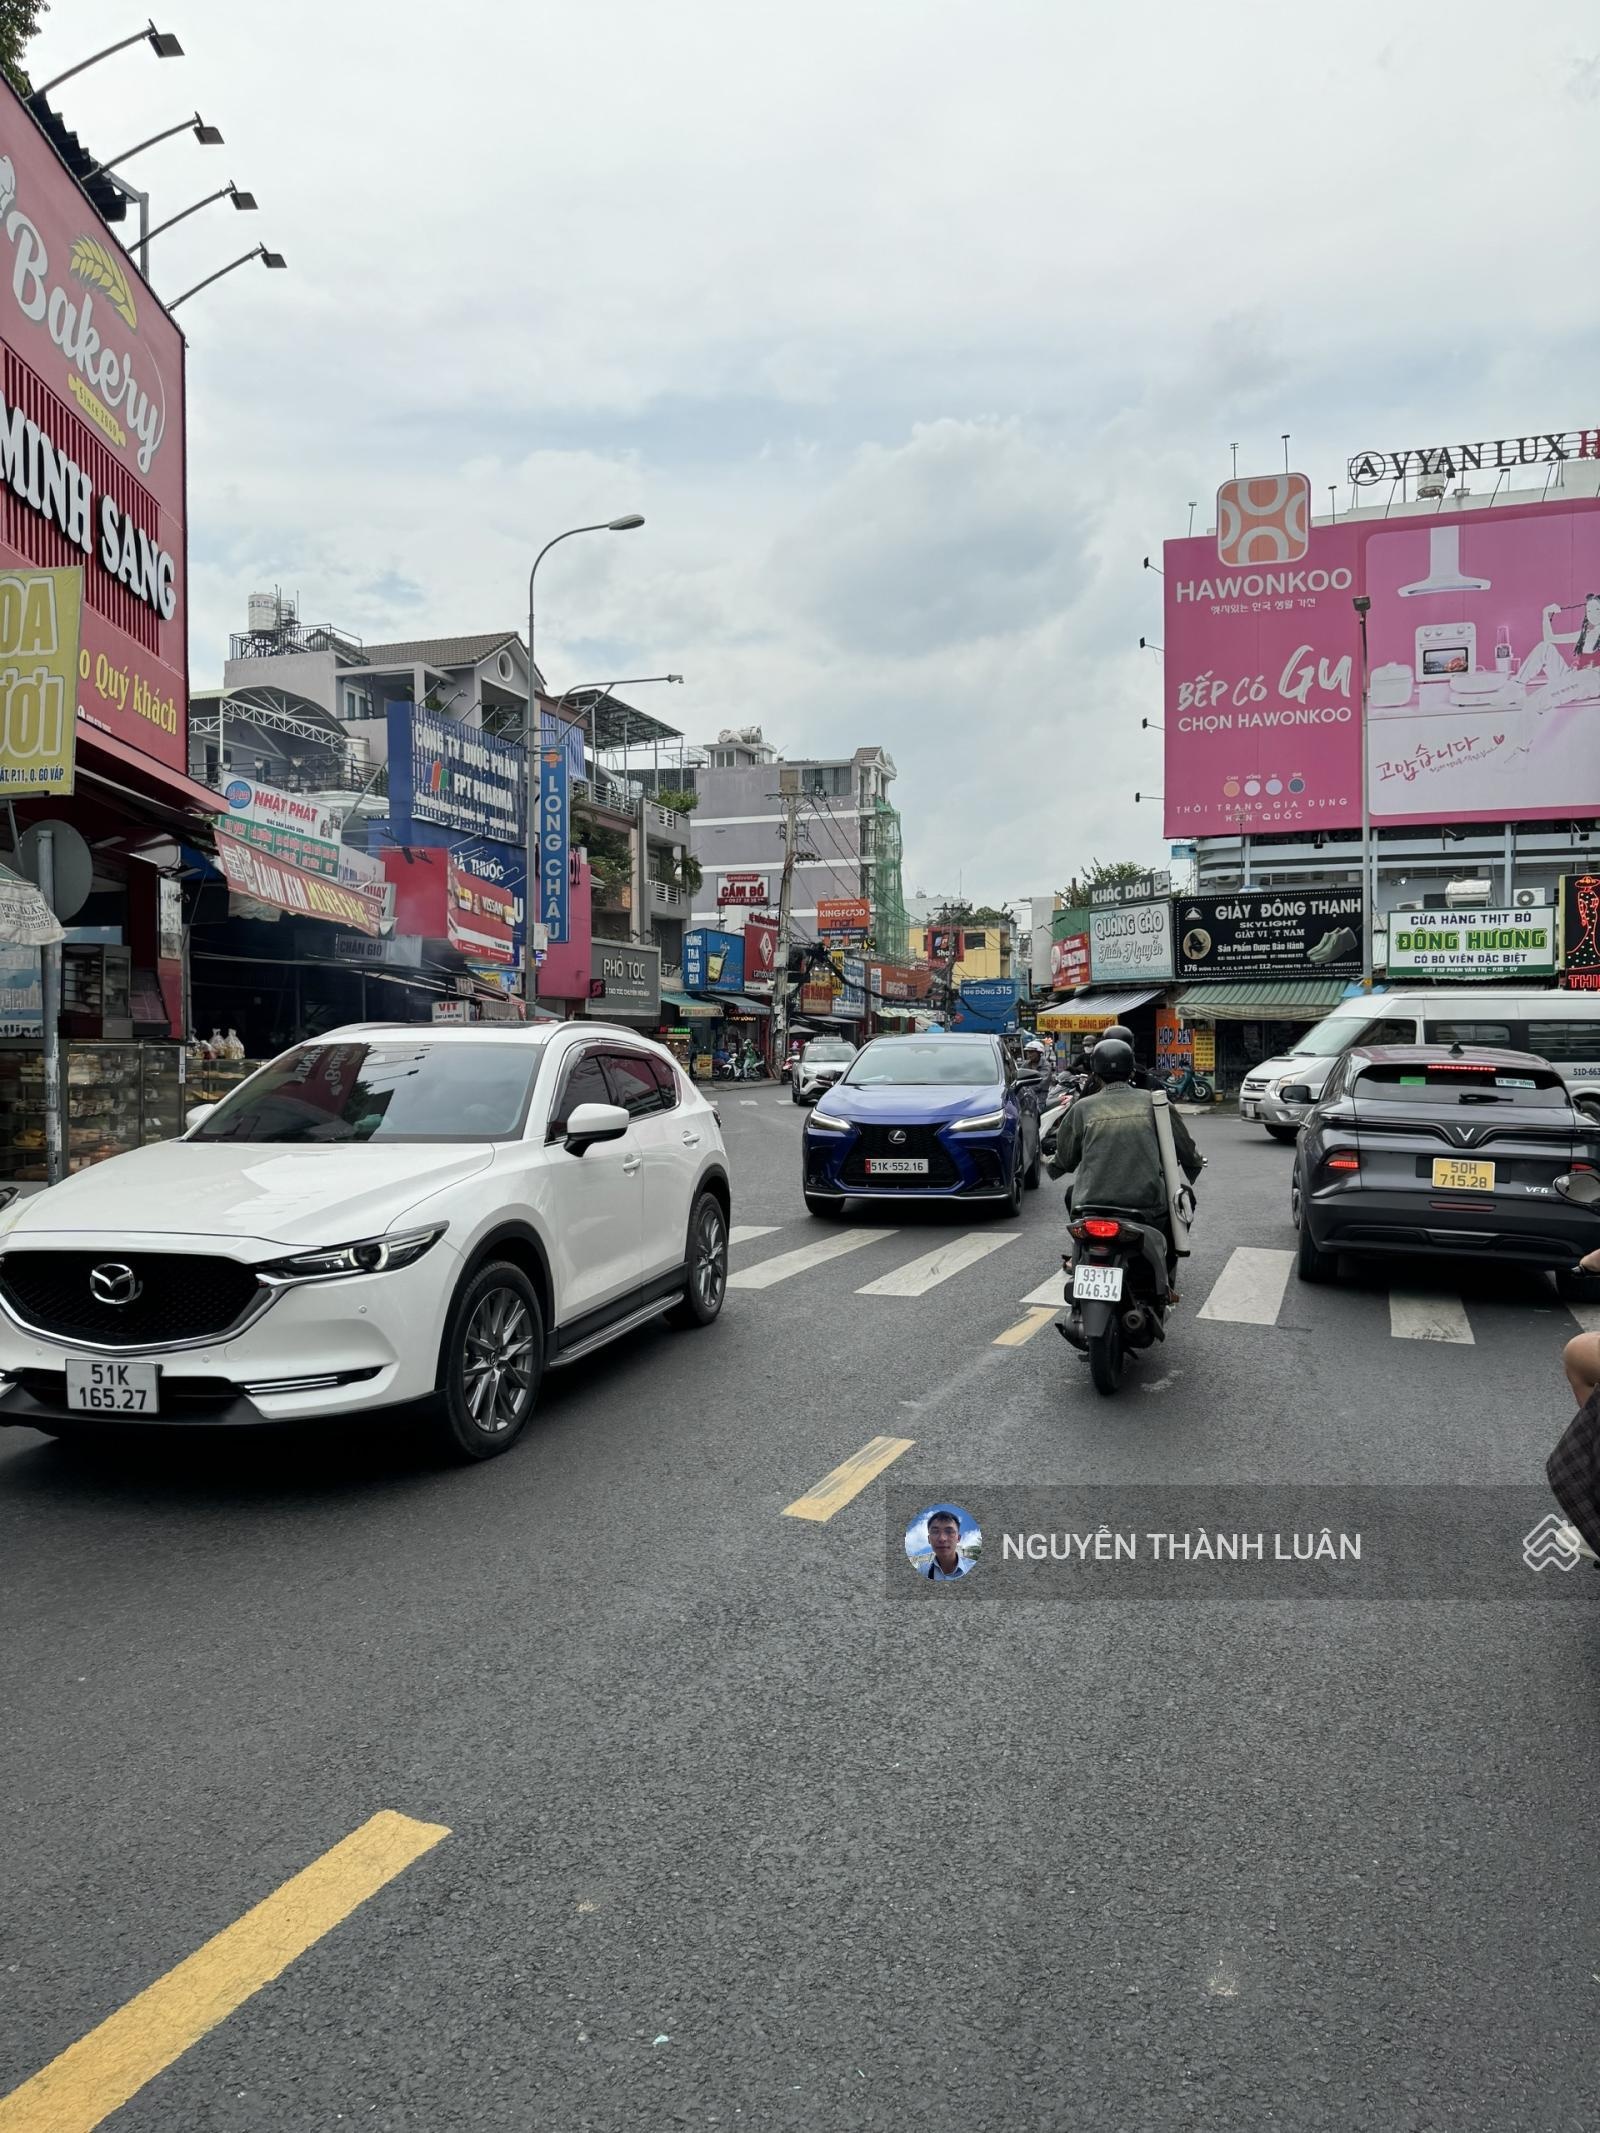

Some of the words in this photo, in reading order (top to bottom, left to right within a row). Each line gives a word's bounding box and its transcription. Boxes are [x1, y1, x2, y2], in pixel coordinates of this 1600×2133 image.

[6, 210, 166, 474] Bakery
[0, 389, 93, 555] MINH
[101, 494, 177, 622] SANG
[1176, 568, 1352, 603] HAWONKOO
[95, 653, 130, 711] Quý
[133, 674, 177, 735] khách
[1178, 714, 1232, 734] CHỌN
[1238, 707, 1351, 728] HAWONKOO
[446, 734, 461, 760] TY
[1375, 736, 1480, 782] 고맙습니다
[453, 773, 473, 798] FPT
[473, 779, 513, 812] PHARMA
[255, 790, 288, 813] NHẬT
[289, 801, 318, 822] PHÁT
[545, 776, 562, 851] LONG
[1176, 804, 1208, 814] THỜI
[1217, 801, 1263, 811] TRANG
[1273, 800, 1298, 809] GIA
[1308, 797, 1348, 807] DỤNG
[1262, 809, 1303, 821] QUỐC
[470, 858, 504, 880] THUỐC
[545, 862, 562, 940] CHÂU
[1092, 884, 1121, 904] KHẮC
[1125, 878, 1151, 899] DẤU
[819, 909, 866, 918] KINGFOOD
[1215, 900, 1251, 920] GIÀY
[1260, 899, 1306, 917] ĐÔNG
[1310, 898, 1362, 918] THẠNH
[1410, 914, 1437, 925] CỬA
[1440, 913, 1476, 925] HÀNG
[1480, 913, 1510, 926] THỊT
[1514, 911, 1532, 923] BÒ
[1095, 911, 1135, 940] QUẢNG
[1138, 907, 1163, 933] CÁO
[1234, 928, 1255, 939] GIÀY
[1283, 928, 1305, 937] NAM
[1239, 920, 1299, 929] SKYLIGHT
[1217, 943, 1231, 953] Sản
[1232, 941, 1251, 952] Phẩm
[1253, 941, 1271, 953] Được
[1271, 941, 1285, 951] Bảo
[1286, 940, 1305, 950] Hành
[1395, 927, 1460, 952] ĐÔNG
[1465, 927, 1548, 951] HƯƠNG
[603, 950, 624, 977] PHỐ
[1184, 964, 1198, 972] 176
[1414, 953, 1428, 964] CÓ
[1431, 952, 1445, 963] BÒ
[1449, 952, 1474, 963] VIÊN
[1477, 954, 1499, 966] ĐẶC
[1503, 953, 1527, 966] BIỆT
[996, 985, 1012, 995] 315
[871, 1162, 924, 1171] 51K-552.16
[1451, 1162, 1477, 1174] 50H
[1440, 1174, 1487, 1188] 715.28
[1083, 1268, 1114, 1284] 93-Y1
[1077, 1283, 1118, 1299] 046.34
[91, 1364, 129, 1385] 51K
[80, 1387, 147, 1410] 165.27
